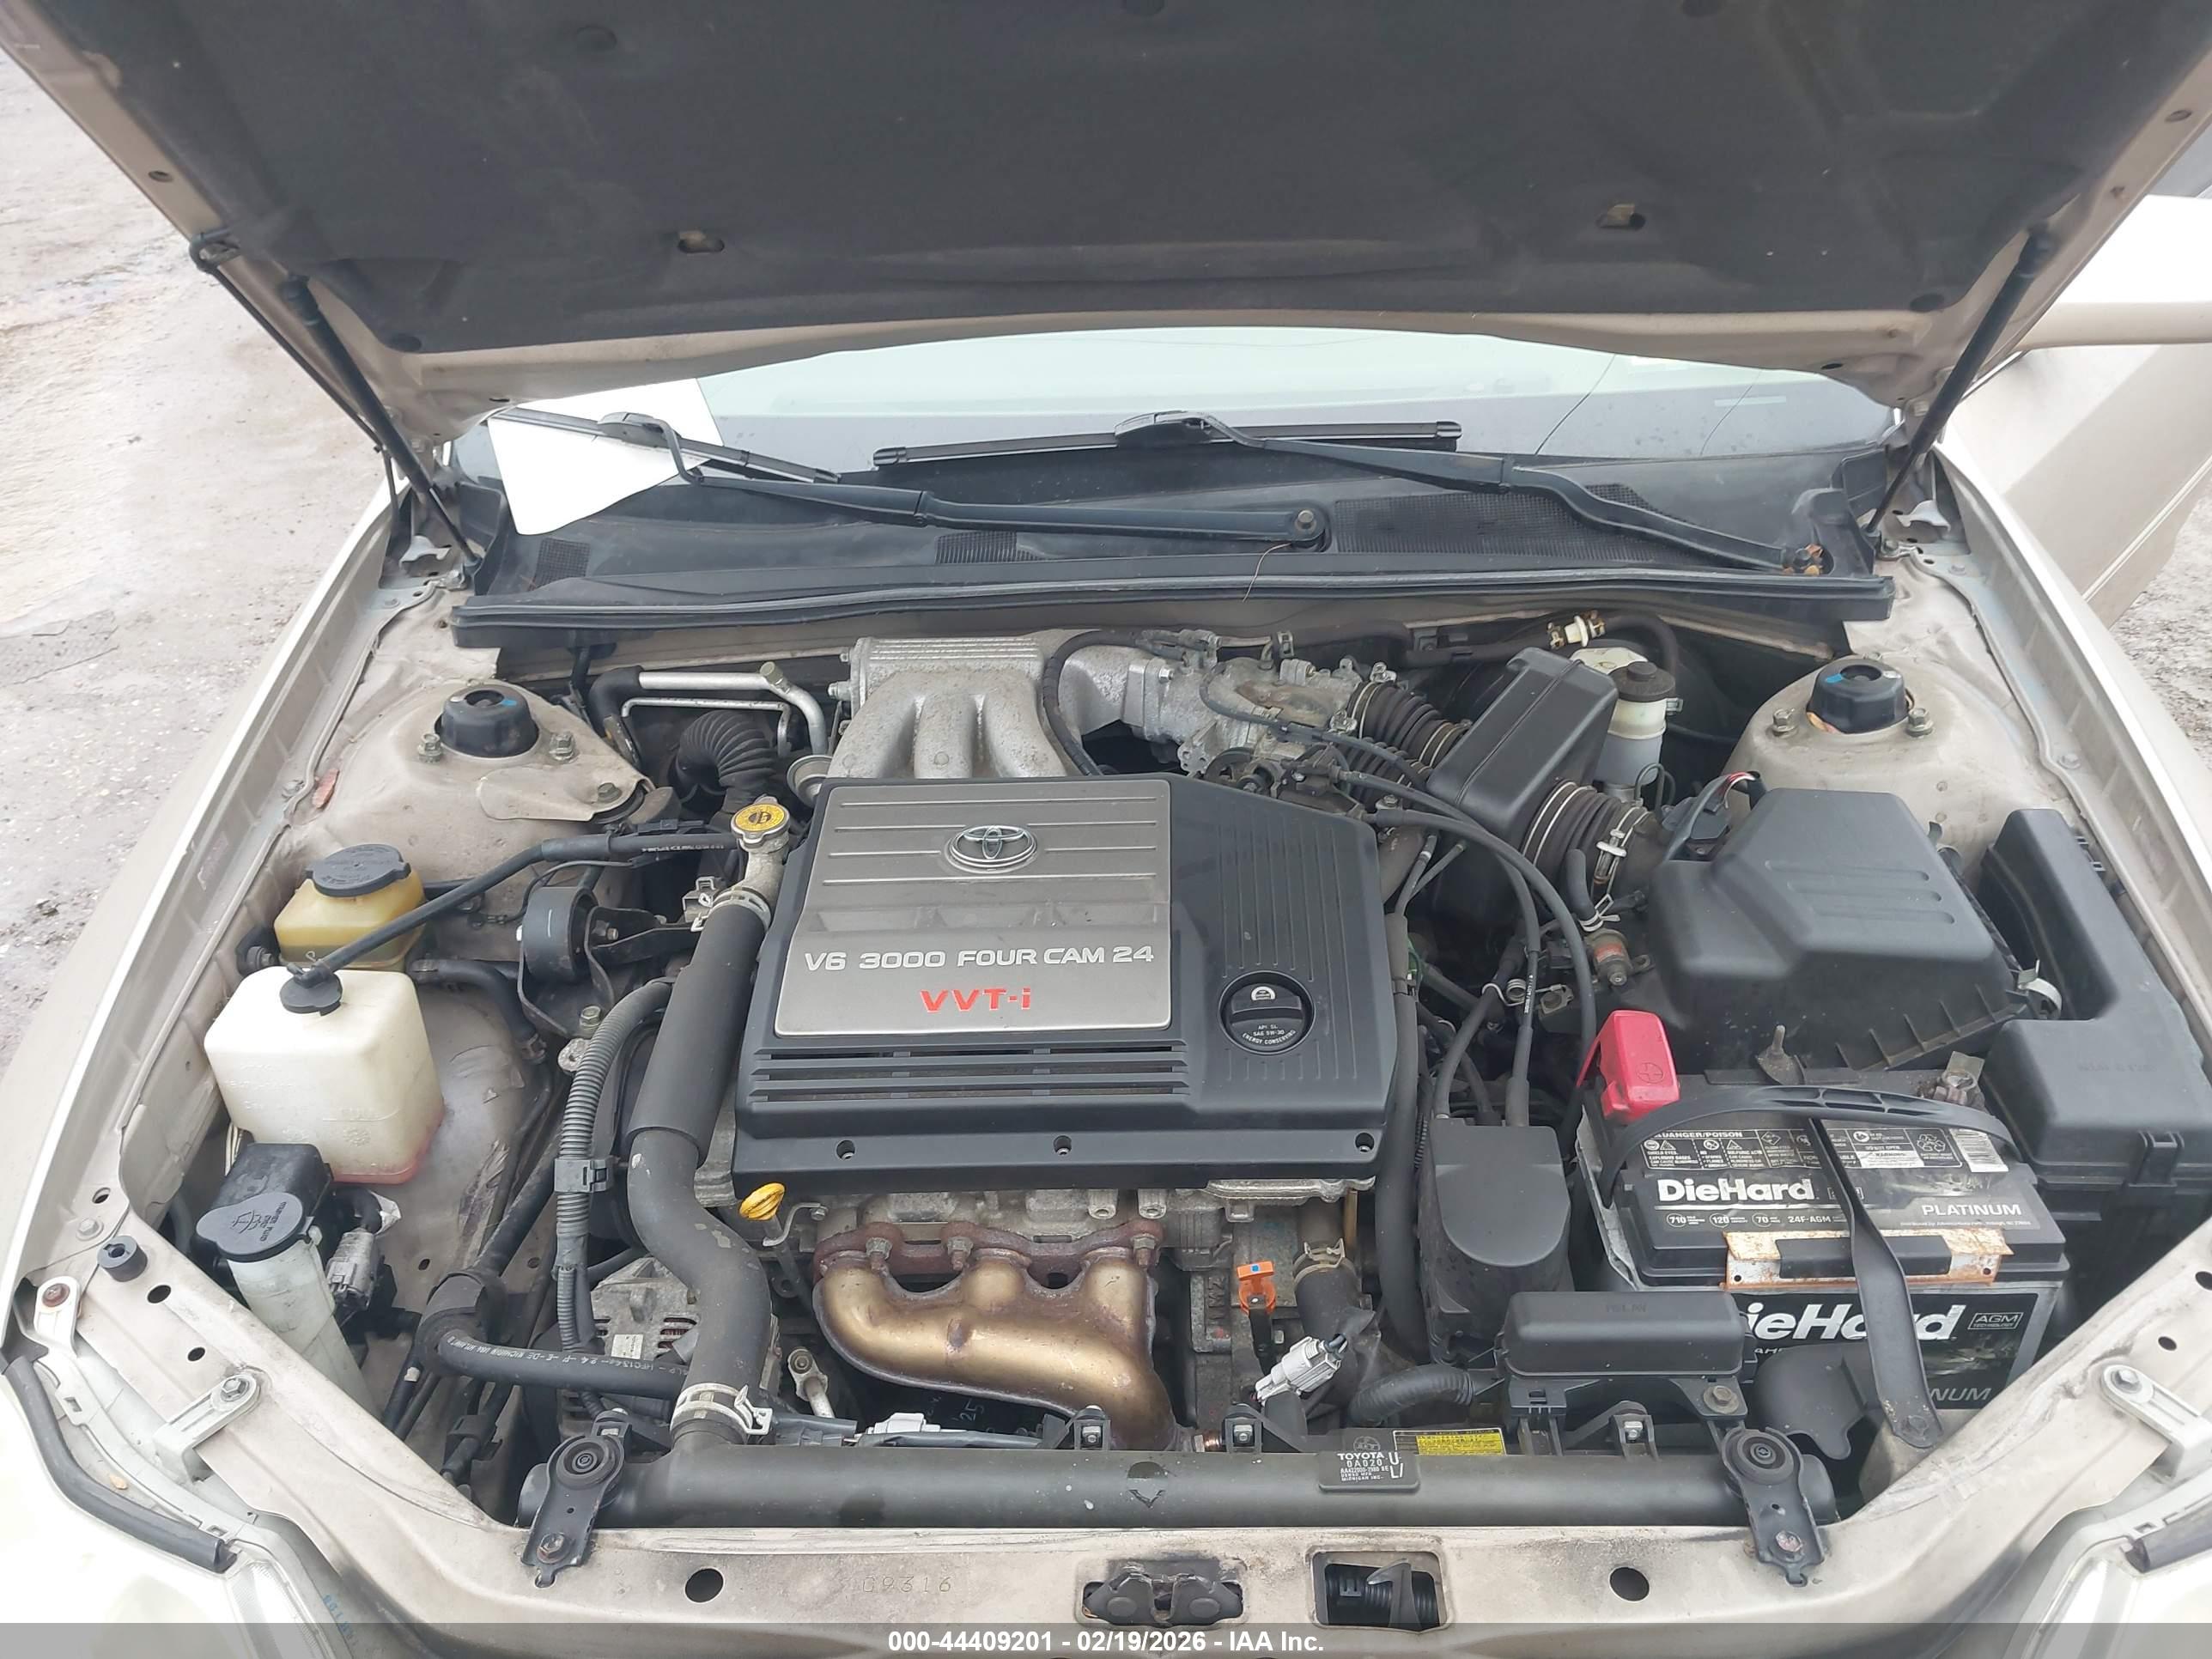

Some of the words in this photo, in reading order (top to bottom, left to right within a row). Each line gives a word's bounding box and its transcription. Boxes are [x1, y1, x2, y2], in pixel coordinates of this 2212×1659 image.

[805, 952, 847, 971] V6
[859, 951, 946, 969] 3000
[957, 949, 1037, 967] FOUR
[1043, 947, 1105, 964] CAM
[1112, 945, 1154, 963] 24
[920, 988, 1030, 1012] VVT-i
[1242, 1032, 1263, 1045] ENERGY
[1656, 1177, 1815, 1201] DieHard
[1921, 1204, 2022, 1216] PLATINUM
[1668, 1215, 1687, 1224] 710
[1711, 1215, 1730, 1224] 120
[1755, 1215, 1769, 1224] 70
[1975, 1315, 2019, 1323] AGM
[1337, 1451, 1384, 1461] TOYOTA
